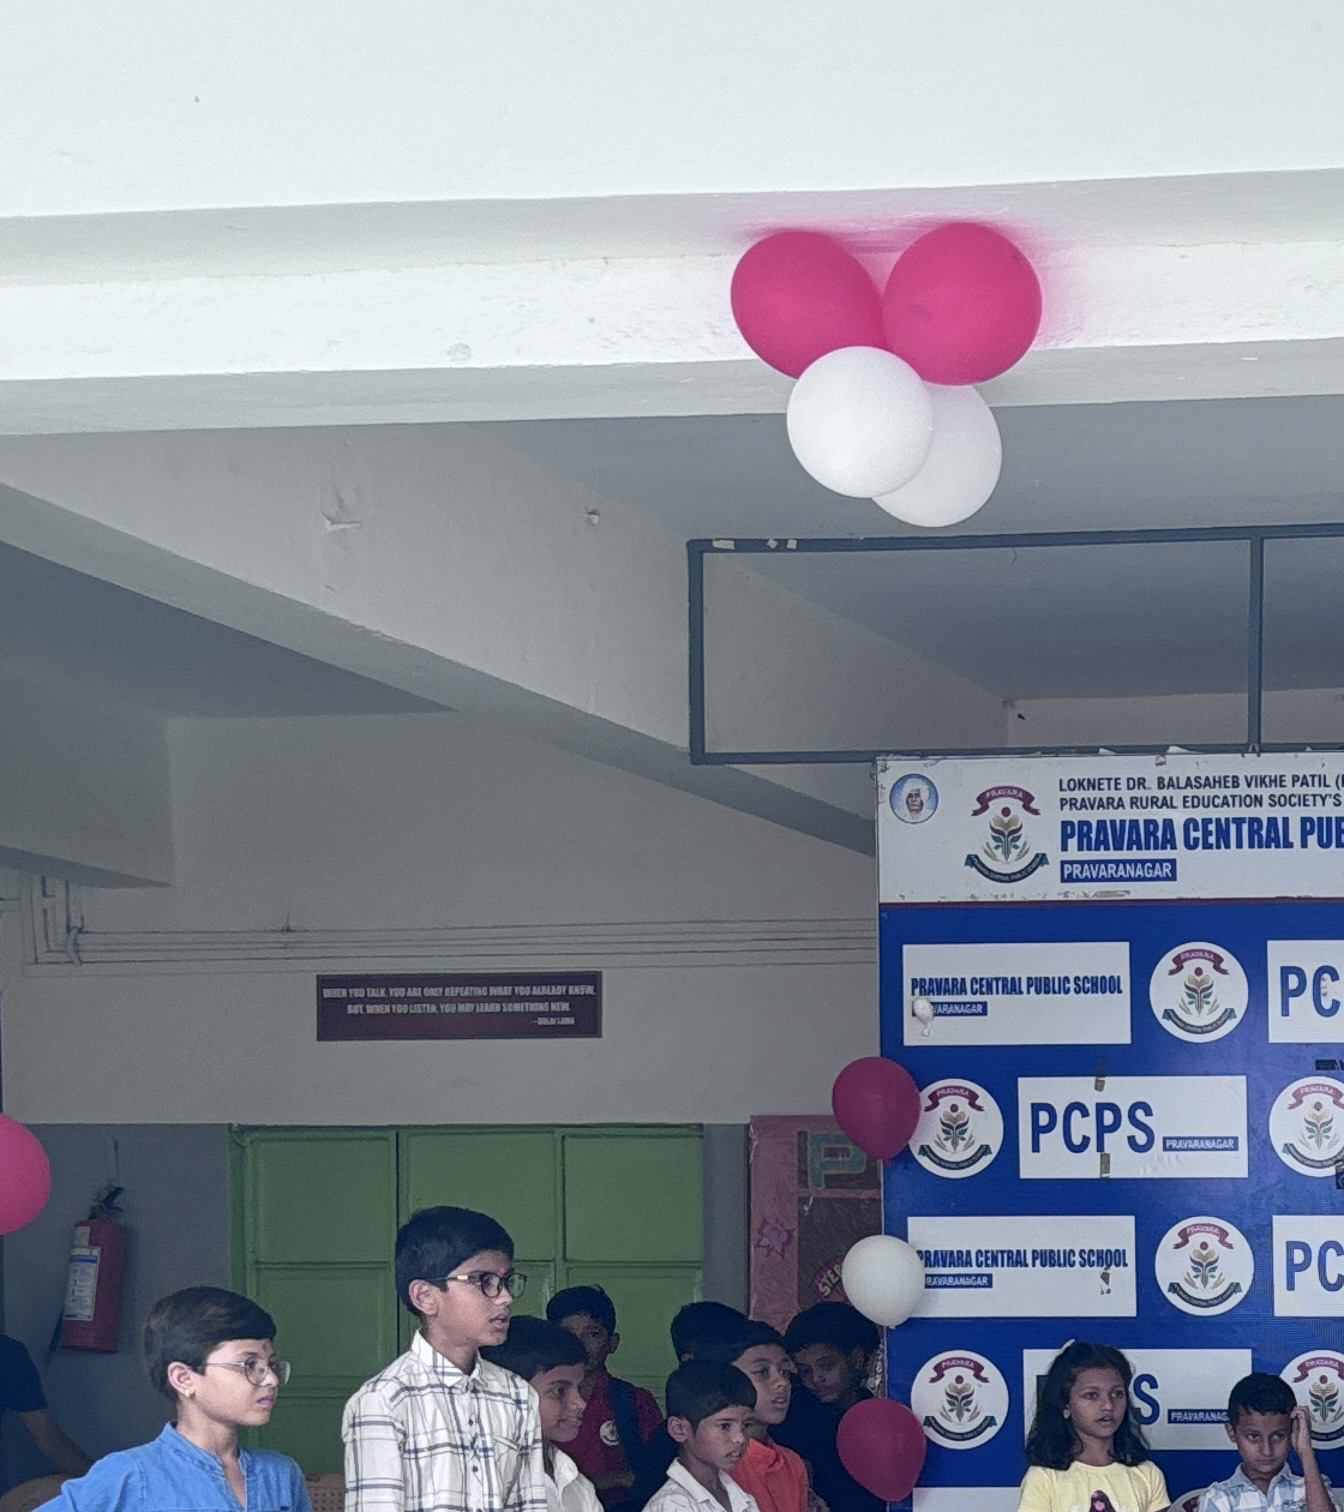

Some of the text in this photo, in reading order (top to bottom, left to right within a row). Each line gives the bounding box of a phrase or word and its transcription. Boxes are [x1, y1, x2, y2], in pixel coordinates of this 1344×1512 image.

[1059, 777, 1122, 791] LOKNETE
[1157, 775, 1240, 790] BALASAHEB
[1244, 774, 1287, 788] VIKHE
[1292, 773, 1331, 788] PATIL
[1060, 793, 1342, 811] PRAVARA RURAL EDUCATION SOCIETY'S
[1060, 818, 1178, 852] PRAVARA
[1183, 816, 1294, 850] CENTRAL
[1063, 863, 1172, 879] PRAVARANAGAR
[911, 975, 1123, 997] PRAVARA CENTRAL PUBLIC SCHOOL
[935, 1003, 983, 1014] ARANAGAR
[1031, 1101, 1155, 1154] PCPS
[975, 1249, 1029, 1268] CENTRAL
[1031, 1248, 1076, 1267] PUBLIC
[1078, 1248, 1129, 1268] SCHOOL
[926, 1276, 989, 1287] RAVARANAGAR
